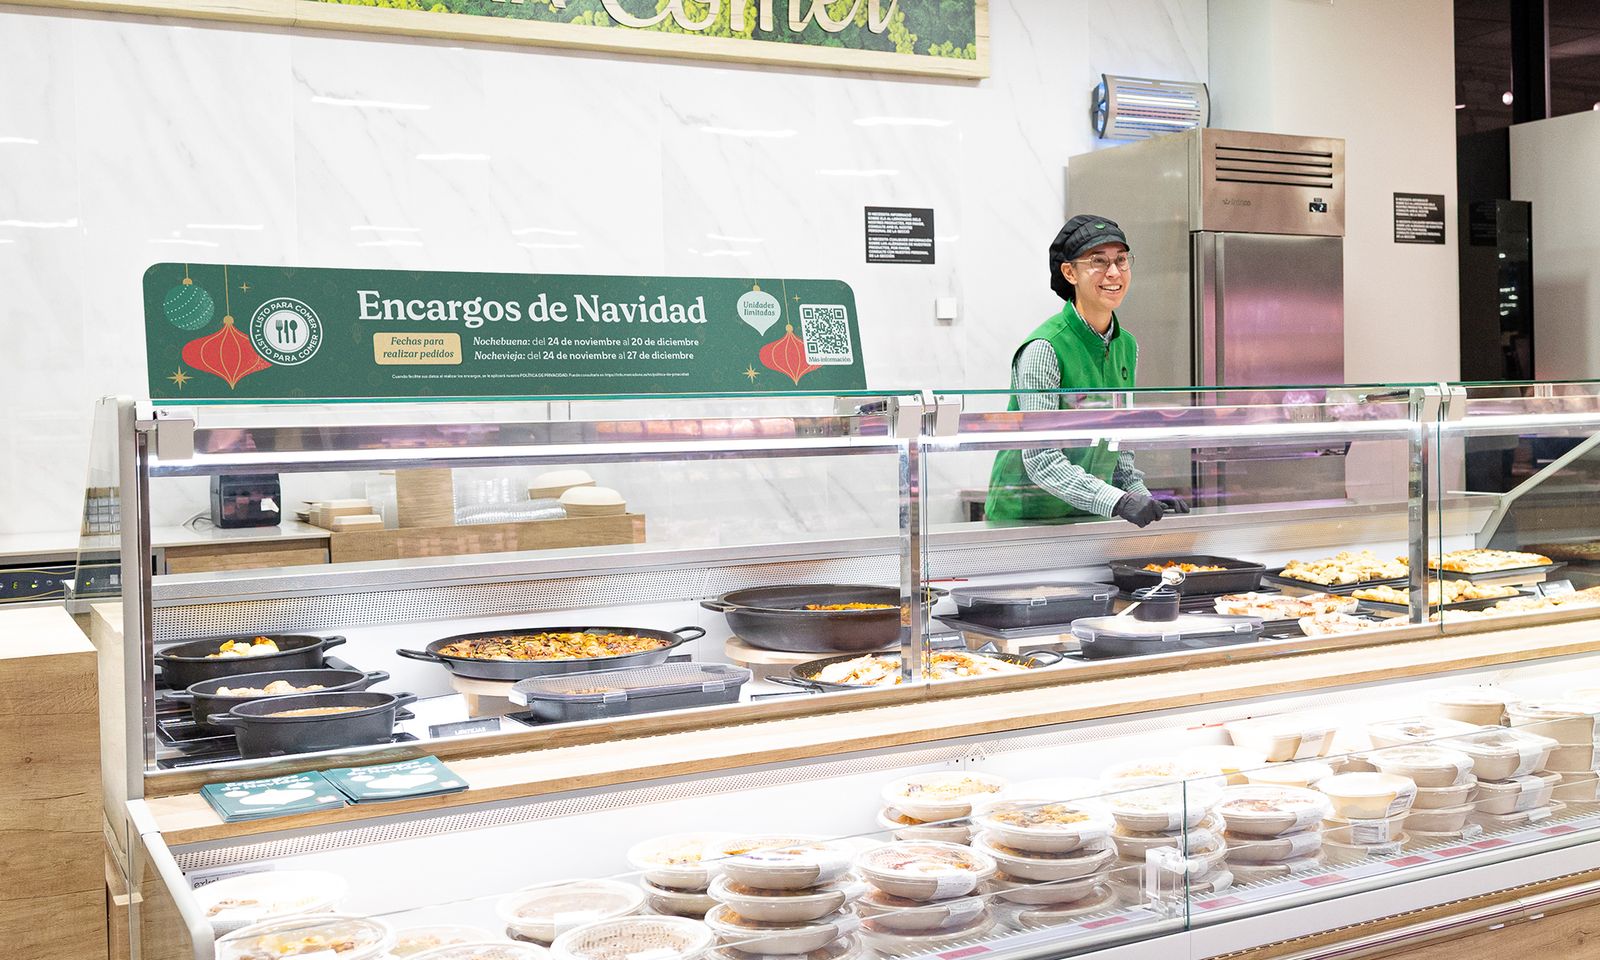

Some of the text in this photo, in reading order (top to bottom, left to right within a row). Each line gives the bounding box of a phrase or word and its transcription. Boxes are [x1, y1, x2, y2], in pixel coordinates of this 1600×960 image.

[357, 290, 708, 328] Encargos de Navidad
[743, 301, 775, 309] Unidades
[255, 301, 317, 329] LISTO PARA COMER
[391, 337, 444, 347] Fechas para
[473, 337, 699, 346] Nochebuena: del 24 de noviembre al 20 de diciembre
[255, 334, 318, 362] LISTO PARA COMER
[383, 350, 454, 360] realizar pedidos
[474, 351, 694, 362] Nochevieja: del 24 de noviembre al 27 de diciembre
